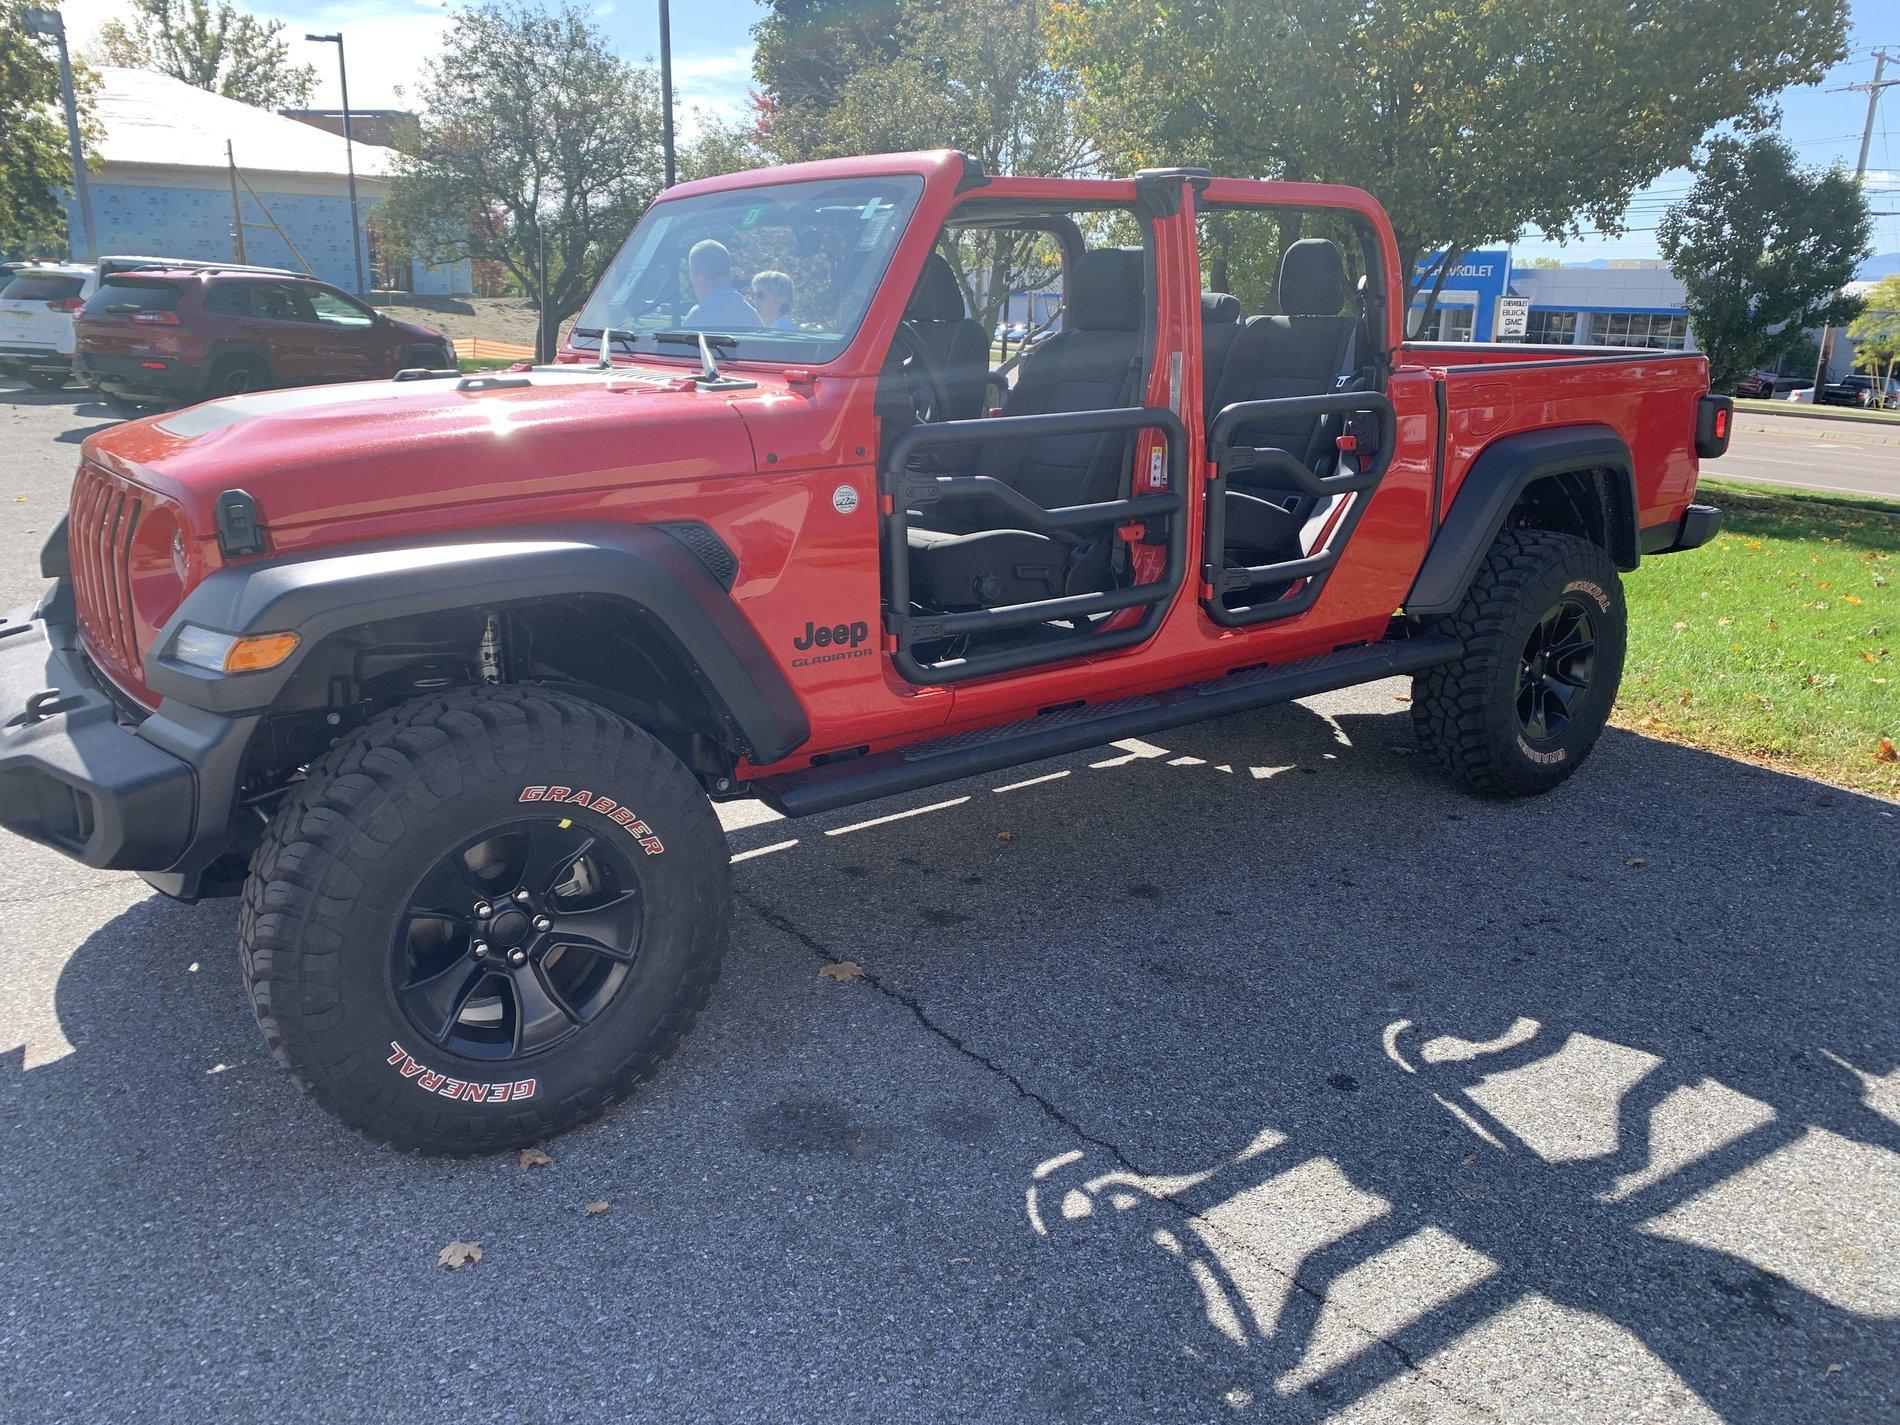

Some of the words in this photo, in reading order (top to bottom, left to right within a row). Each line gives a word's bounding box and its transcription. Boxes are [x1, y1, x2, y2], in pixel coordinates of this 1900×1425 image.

[1504, 318, 1522, 326] GMC
[1562, 580, 1611, 614] GENERAL
[793, 621, 868, 651] Jeep
[791, 648, 873, 668] GLADIATOR
[518, 785, 665, 856] GRABBER
[386, 1040, 536, 1103] GENERAL
